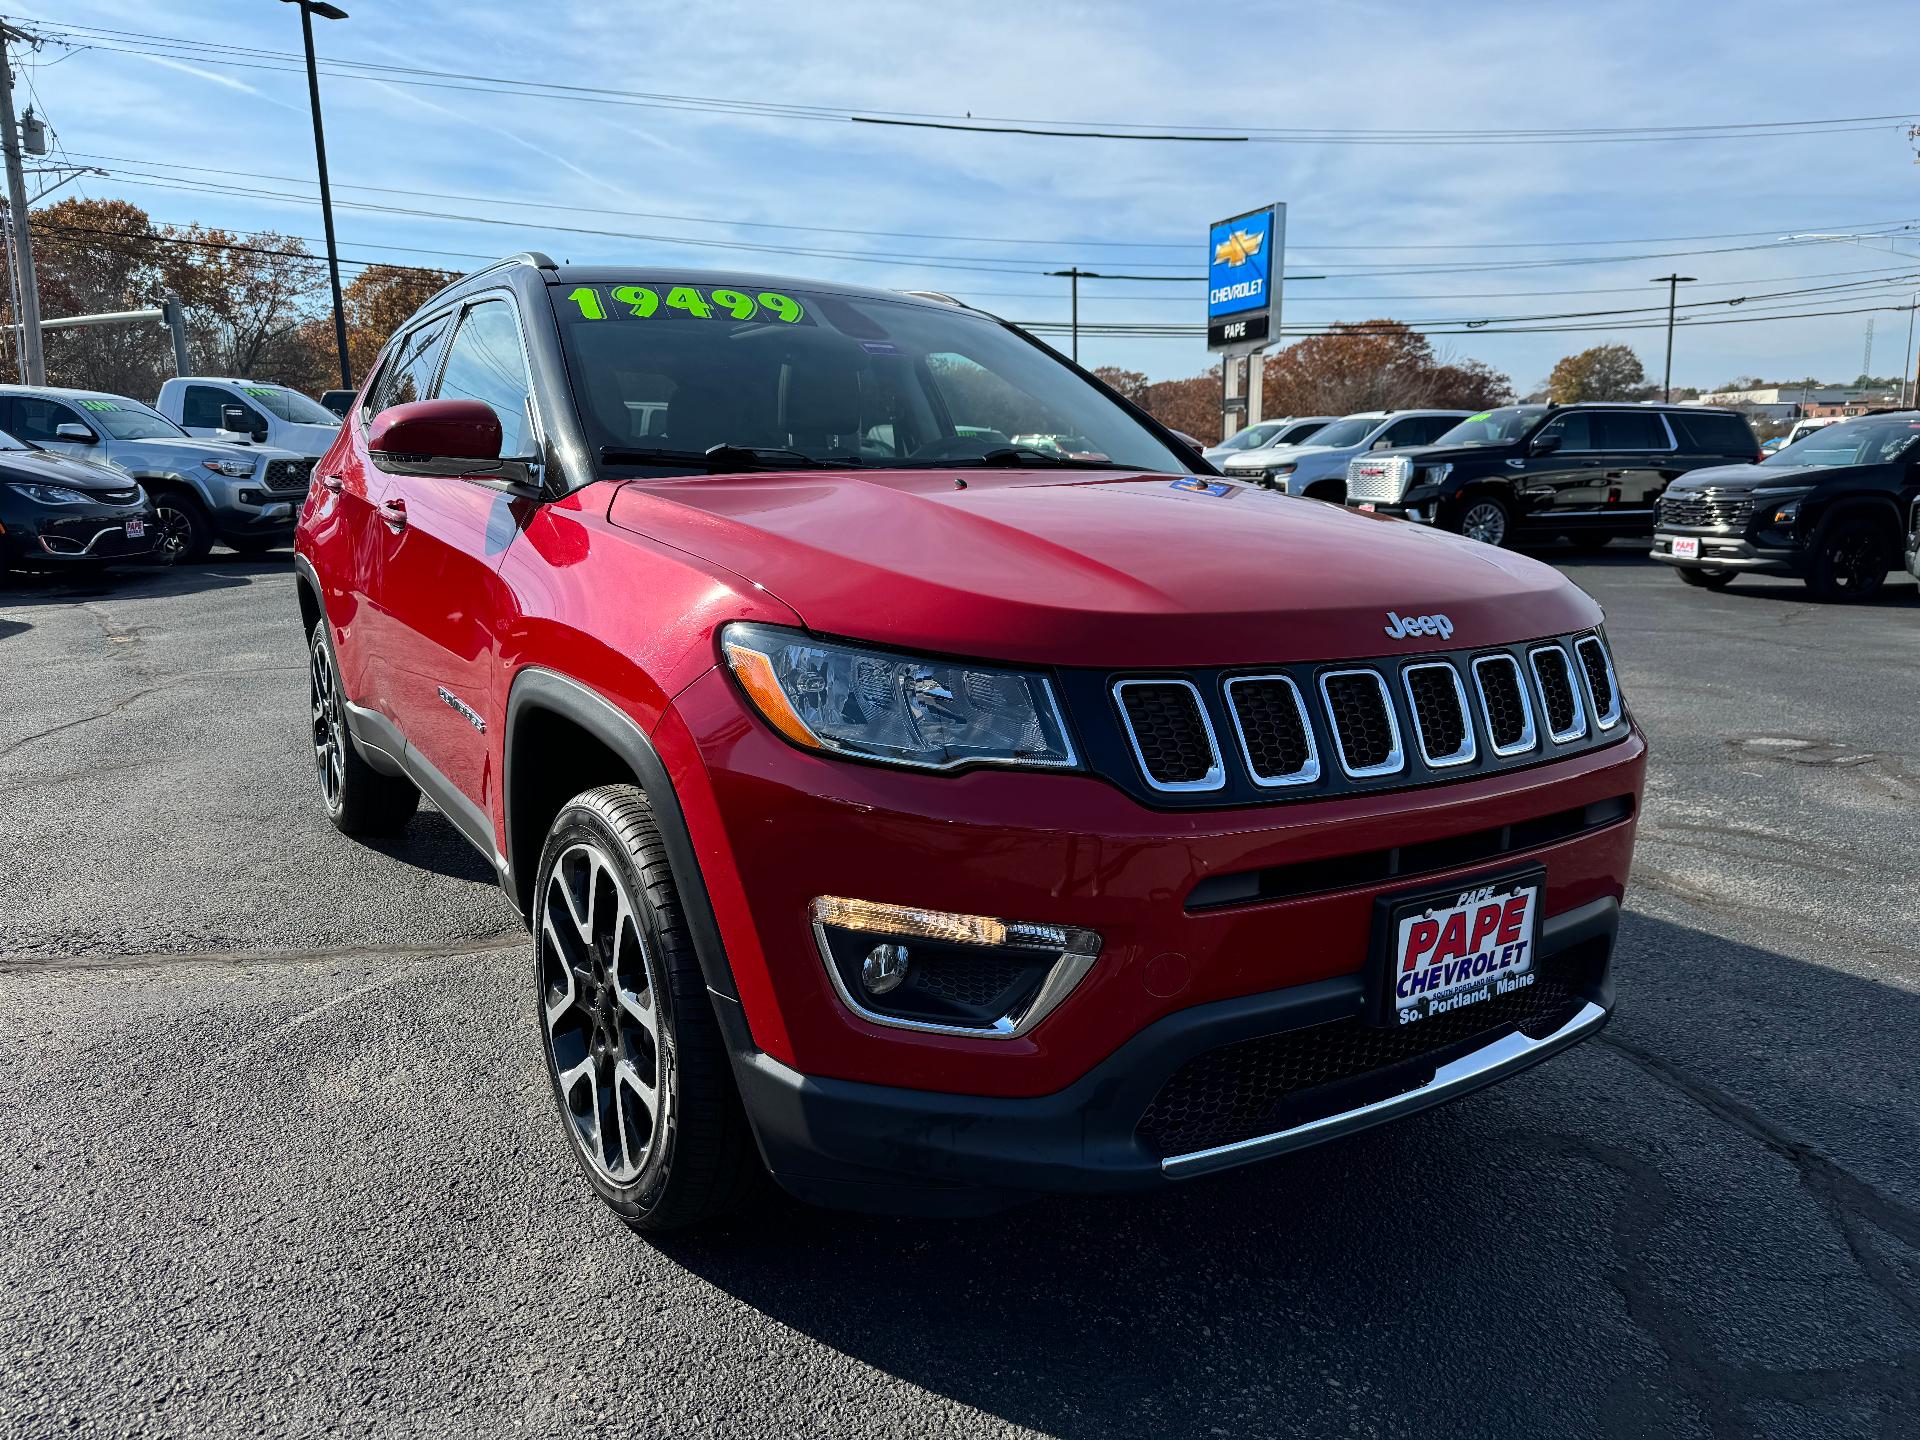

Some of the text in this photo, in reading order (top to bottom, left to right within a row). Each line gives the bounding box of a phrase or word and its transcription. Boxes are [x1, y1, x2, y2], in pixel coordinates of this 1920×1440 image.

[568, 285, 804, 324] 19499
[1211, 279, 1263, 304] CHEVROLET
[1224, 321, 1247, 339] PAPE
[1384, 611, 1454, 640] Jeep
[1457, 886, 1495, 906] PAPE
[1403, 897, 1529, 971] PAPE
[1397, 941, 1528, 999] CHEVROLET
[1399, 972, 1535, 1025] So. Portland, Maine
[1432, 987, 1453, 1000] SOUTH
[1454, 977, 1486, 993] PORTLAND
